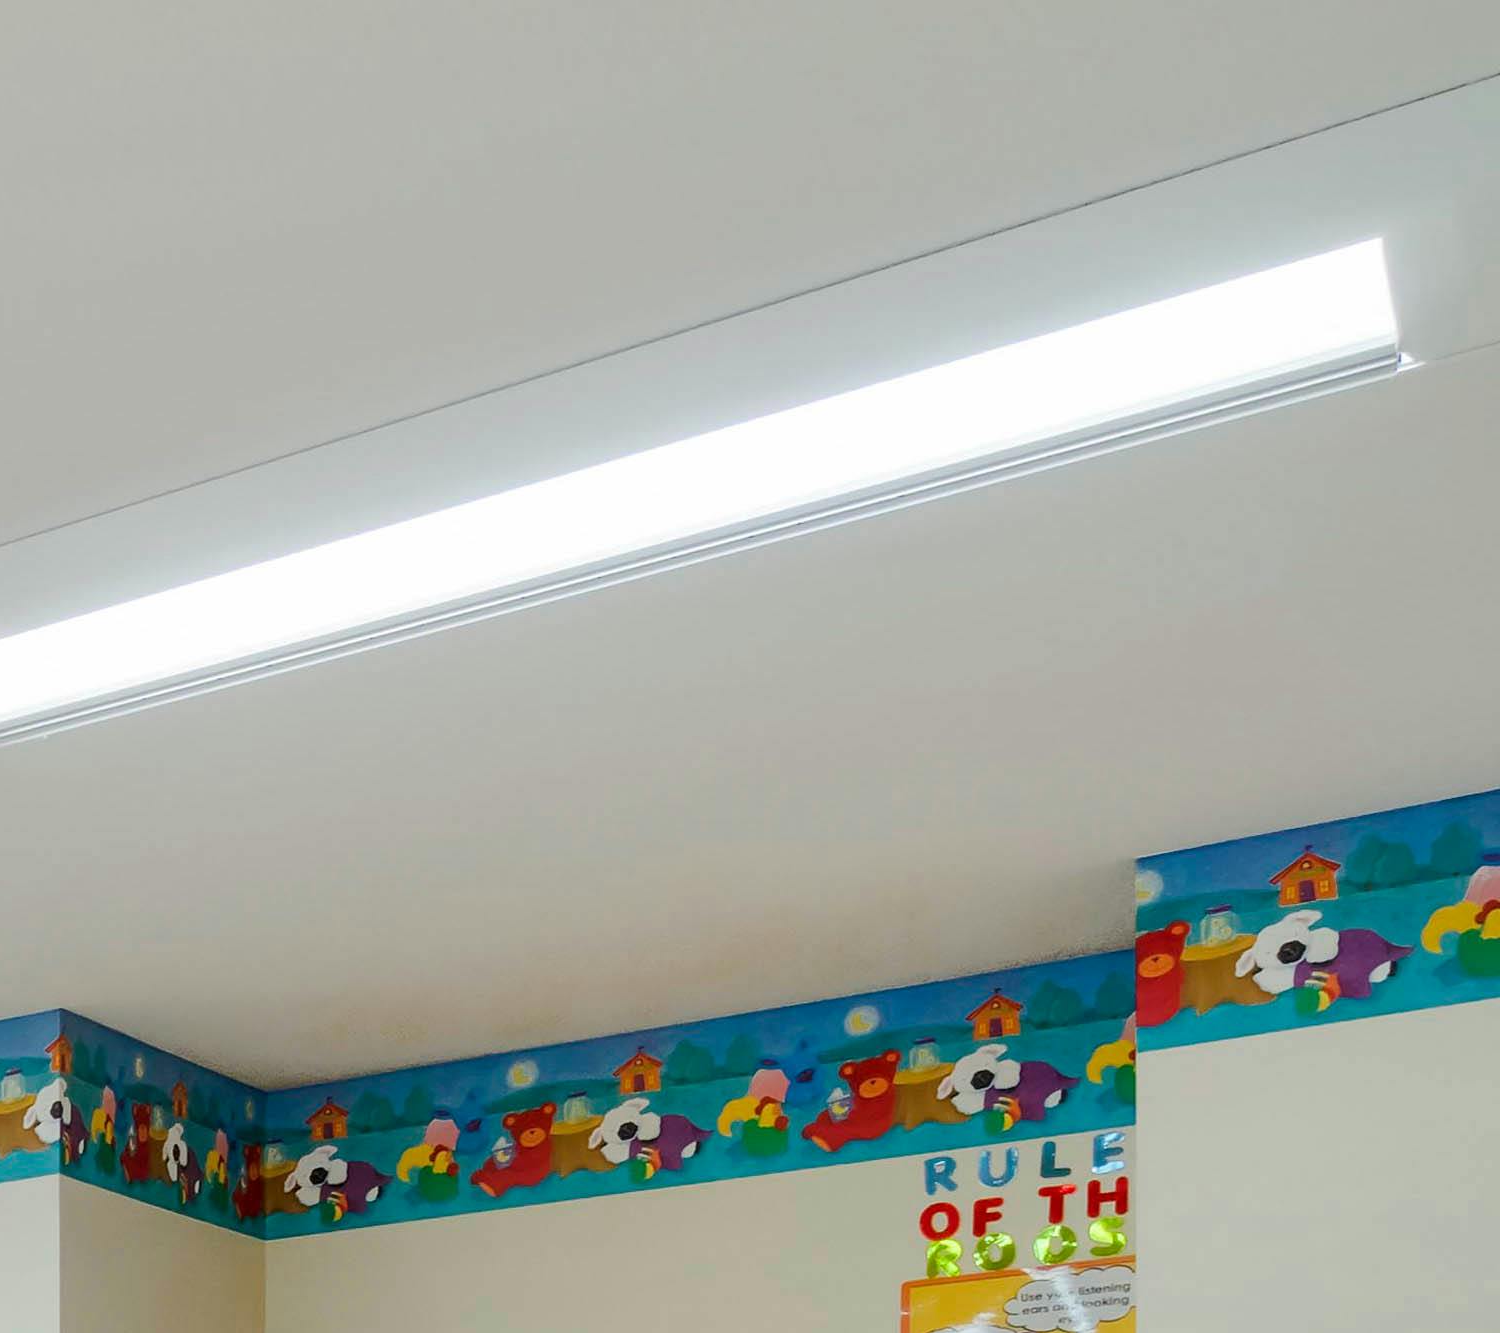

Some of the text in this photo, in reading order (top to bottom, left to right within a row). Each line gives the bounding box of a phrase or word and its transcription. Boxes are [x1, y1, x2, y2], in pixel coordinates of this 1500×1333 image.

[919, 1197, 1004, 1241] OF
[1020, 1293, 1043, 1302] Use
[1078, 1282, 1131, 1296] listening
